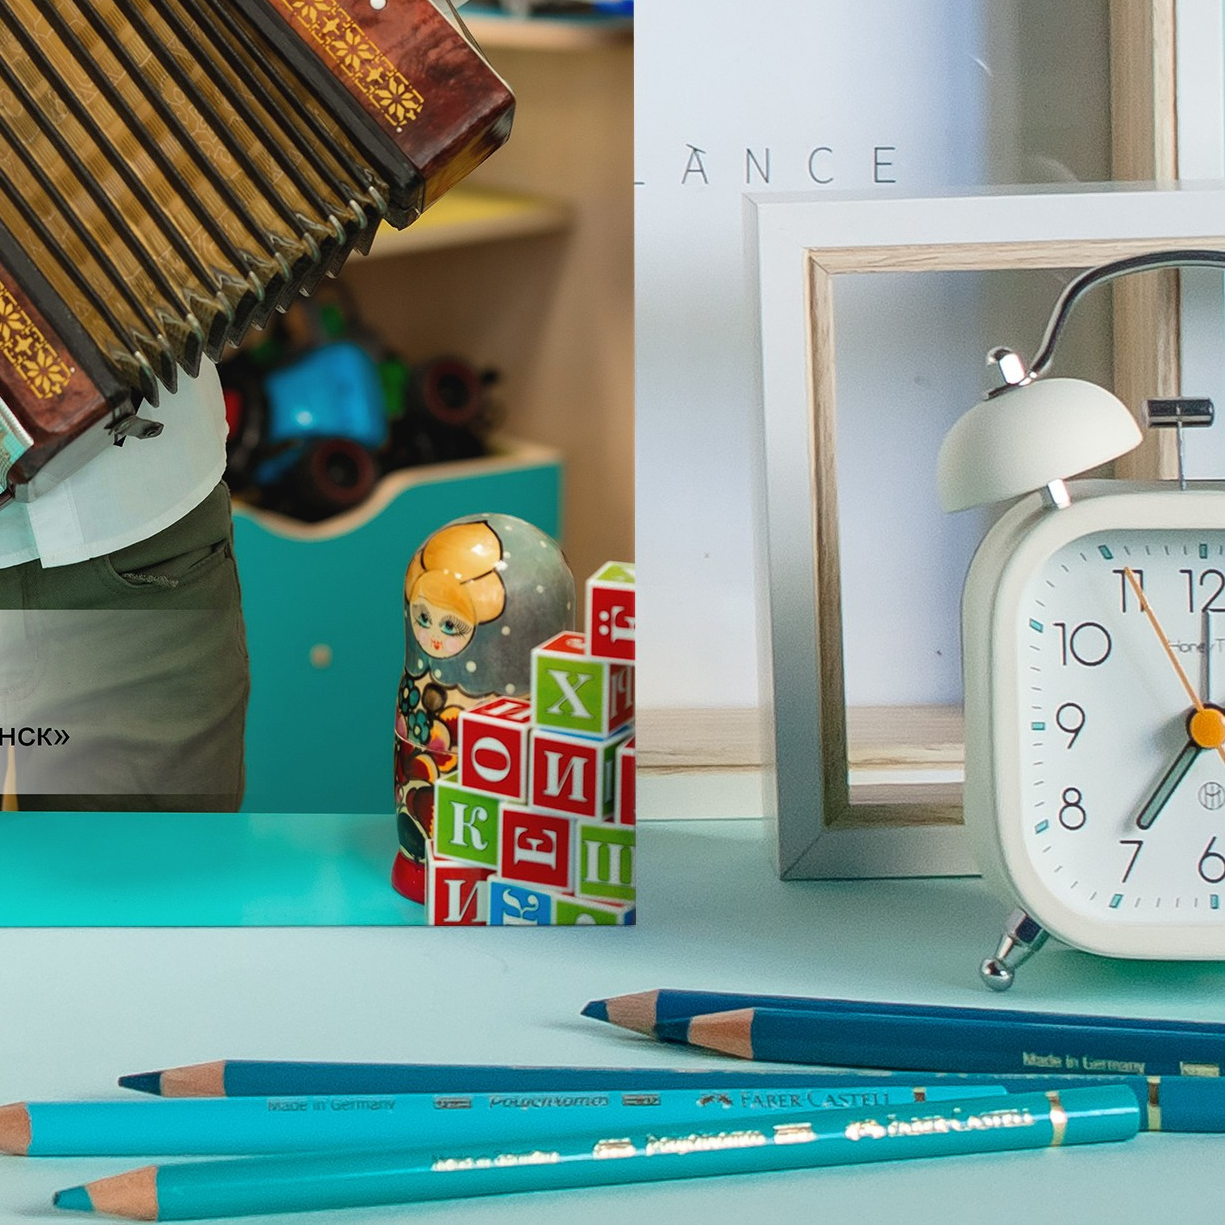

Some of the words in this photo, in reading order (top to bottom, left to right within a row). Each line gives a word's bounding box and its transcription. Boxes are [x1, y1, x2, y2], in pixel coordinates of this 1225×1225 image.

[634, 144, 896, 184] ANCE
[1113, 569, 1143, 612] 11
[1179, 569, 1225, 613] 12
[1053, 622, 1112, 666] 10
[1056, 702, 1085, 749] 9
[1059, 787, 1086, 830] 8
[1120, 840, 1143, 883] 7
[1198, 836, 1225, 883] 6
